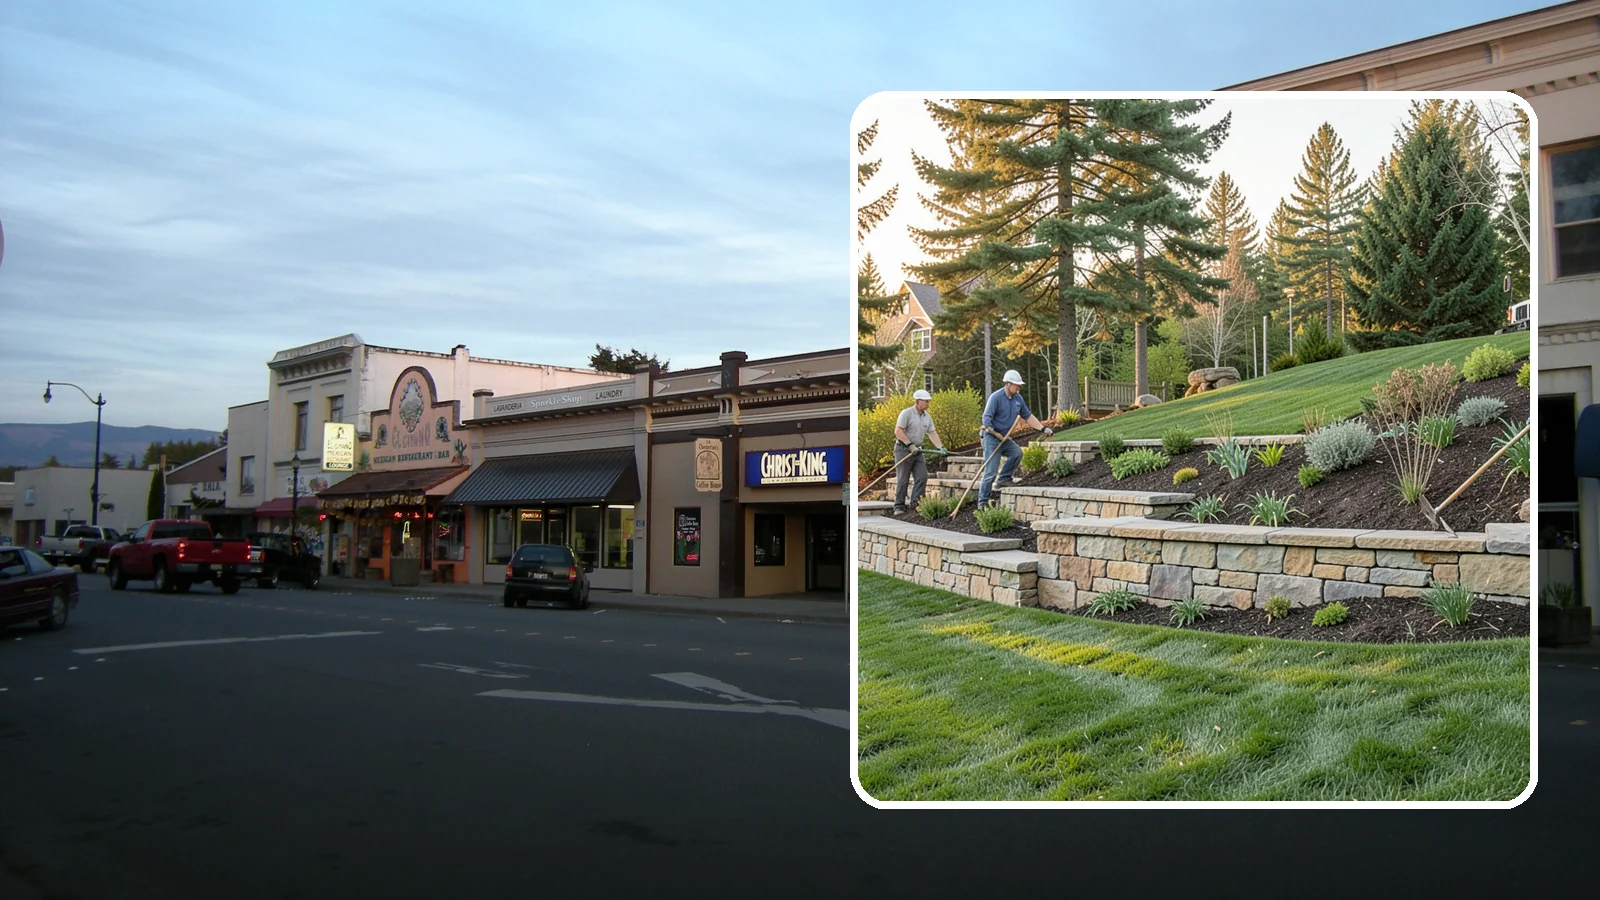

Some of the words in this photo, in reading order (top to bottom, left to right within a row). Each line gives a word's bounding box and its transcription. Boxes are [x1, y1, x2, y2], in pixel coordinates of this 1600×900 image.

[562, 394, 582, 405] Shop
[596, 389, 624, 399] LAUNDRY
[493, 402, 523, 412] LAVANDERIA
[373, 455, 396, 464] MEXICAN
[397, 451, 433, 462] RESTAURANT
[437, 450, 450, 459] BAR
[760, 452, 797, 478] CHRIST
[799, 450, 827, 476] KING
